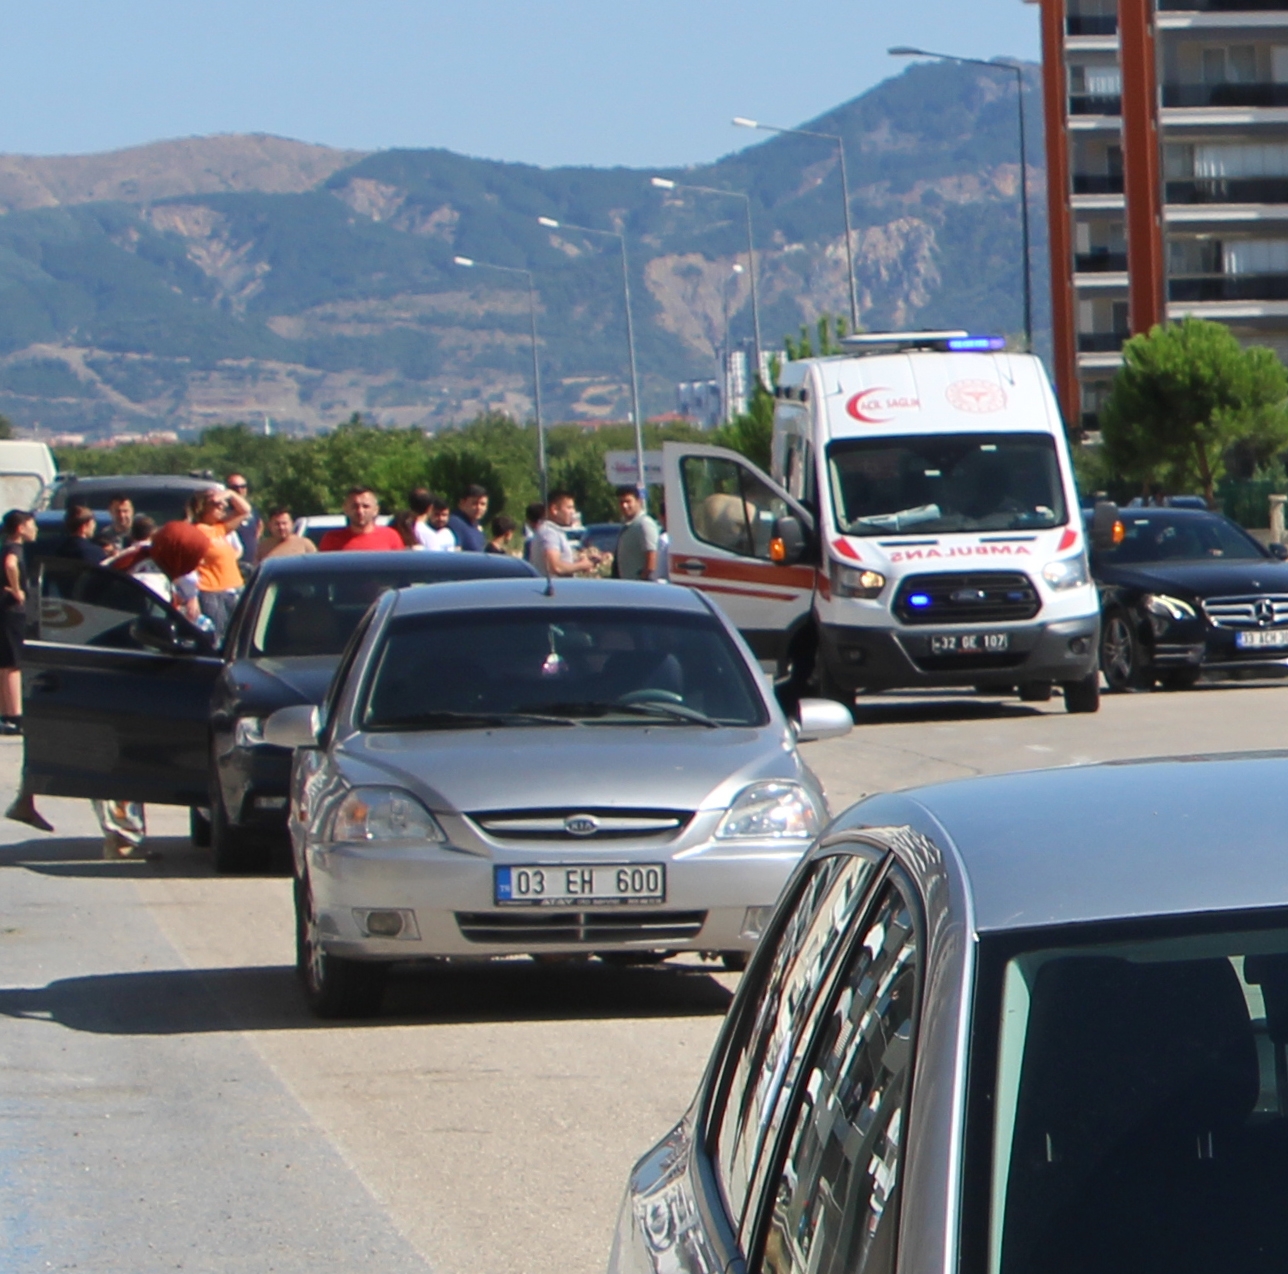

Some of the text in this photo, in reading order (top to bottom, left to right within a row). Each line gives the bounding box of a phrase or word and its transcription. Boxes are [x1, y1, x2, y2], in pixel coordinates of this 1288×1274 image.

[942, 636, 956, 649] 32
[984, 633, 1004, 648] 107
[517, 869, 659, 894] 03 EH 600
